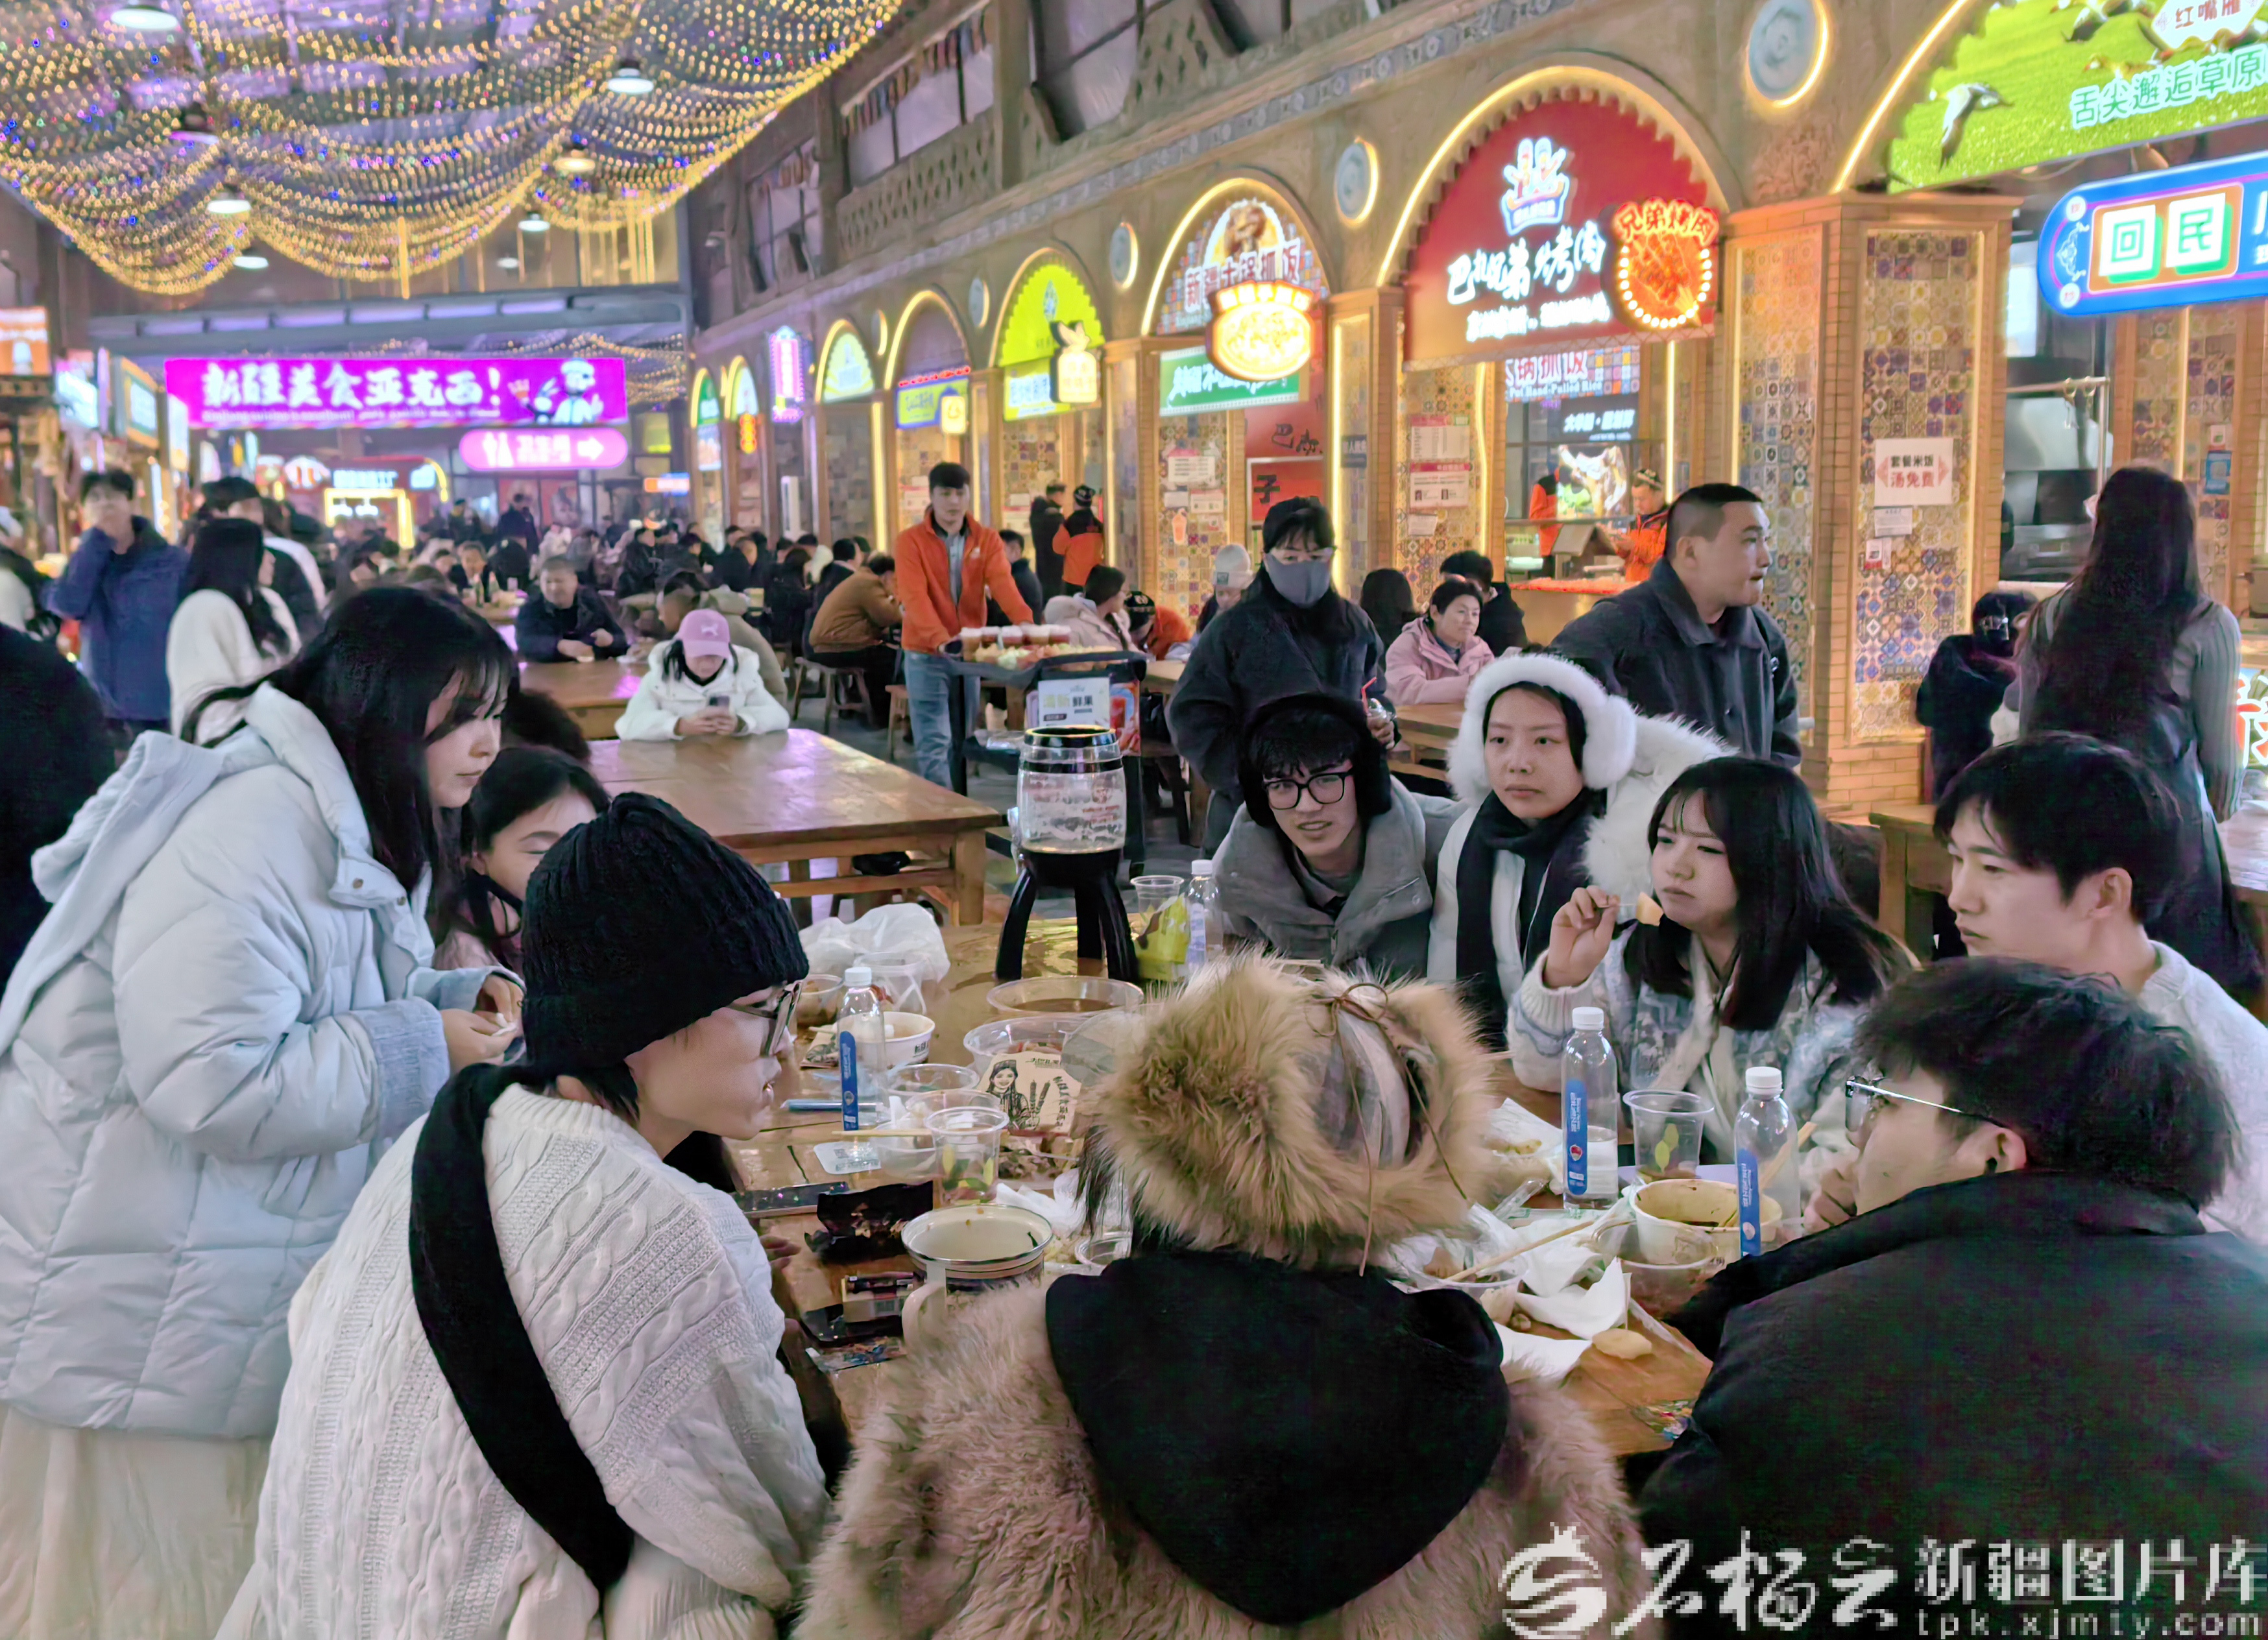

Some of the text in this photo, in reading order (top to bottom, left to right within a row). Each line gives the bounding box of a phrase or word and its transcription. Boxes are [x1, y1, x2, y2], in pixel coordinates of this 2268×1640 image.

[2073, 45, 2265, 125] 舌尖邂逅草原
[1615, 197, 1719, 247] 兄弟烤肉
